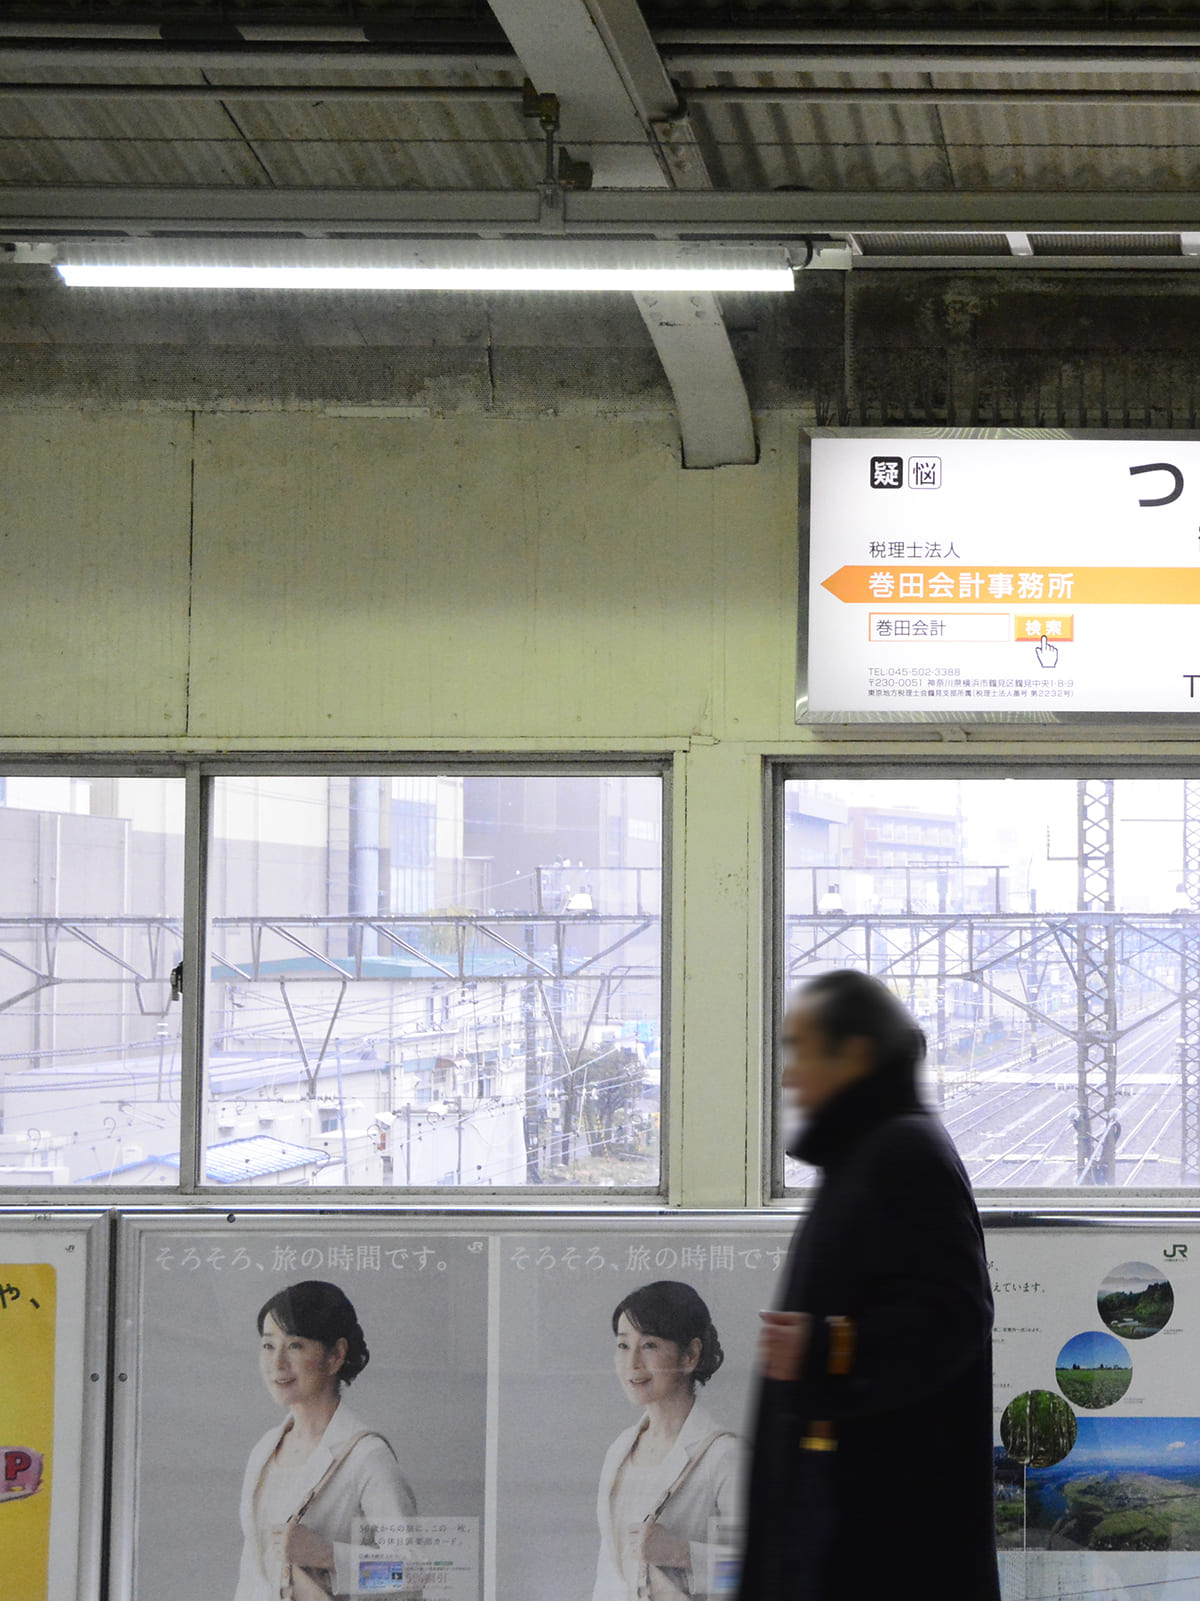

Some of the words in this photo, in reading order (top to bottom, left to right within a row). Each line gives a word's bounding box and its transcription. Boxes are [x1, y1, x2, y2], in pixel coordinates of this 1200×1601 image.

[873, 460, 900, 487] 疑
[912, 461, 937, 486] 悩
[868, 540, 961, 559] 税理士法人
[868, 571, 1075, 600] 巻田会計事務所
[876, 619, 947, 637] 巻田会計
[1024, 619, 1063, 636] 検索
[154, 1244, 448, 1272] そろそろ、旅の時間です。
[1163, 1244, 1188, 1258] JR
